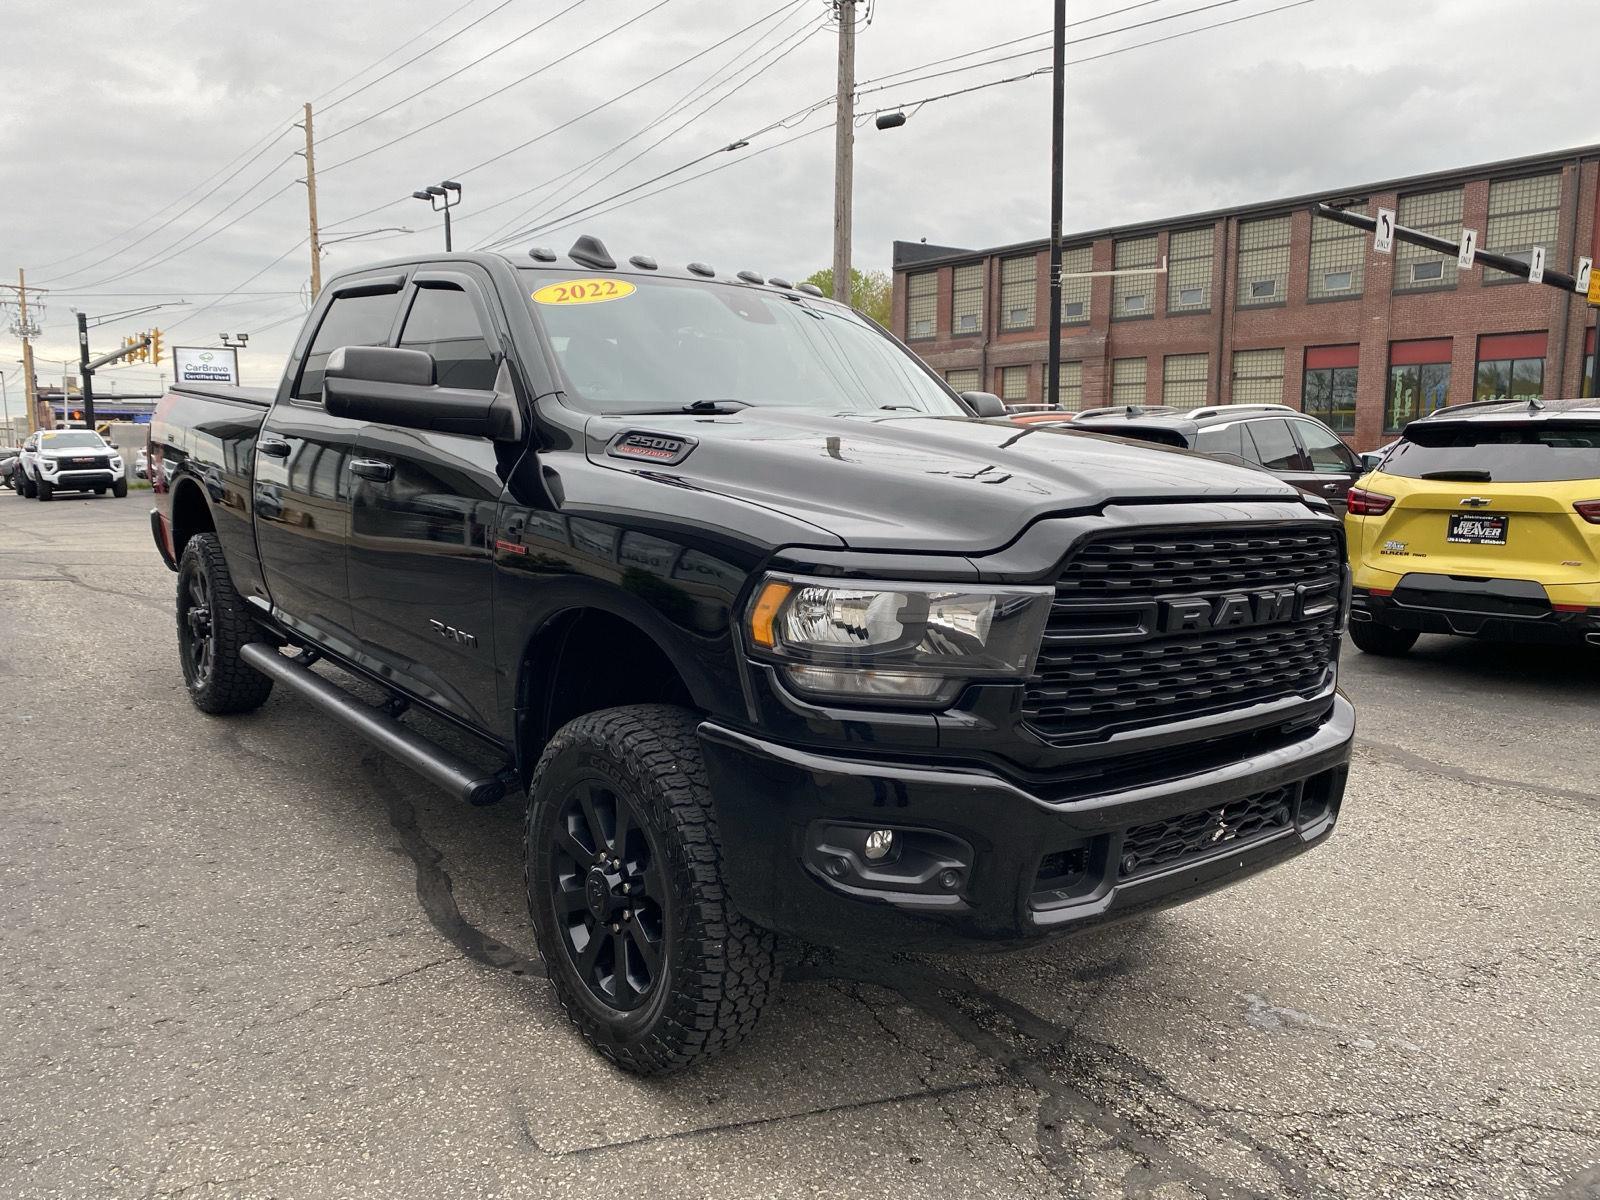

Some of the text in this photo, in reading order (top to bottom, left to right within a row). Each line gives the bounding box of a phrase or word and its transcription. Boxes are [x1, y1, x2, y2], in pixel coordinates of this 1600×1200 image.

[1376, 240, 1390, 248] ONLY
[1461, 255, 1471, 264] ONLY
[1532, 270, 1541, 279] ONLY
[553, 281, 618, 302] 2022
[185, 364, 228, 372] CarBravo
[626, 434, 680, 452] 2500
[1453, 526, 1502, 536] WEAVER
[1160, 589, 1295, 632] RAM
[430, 618, 478, 649] RAM
